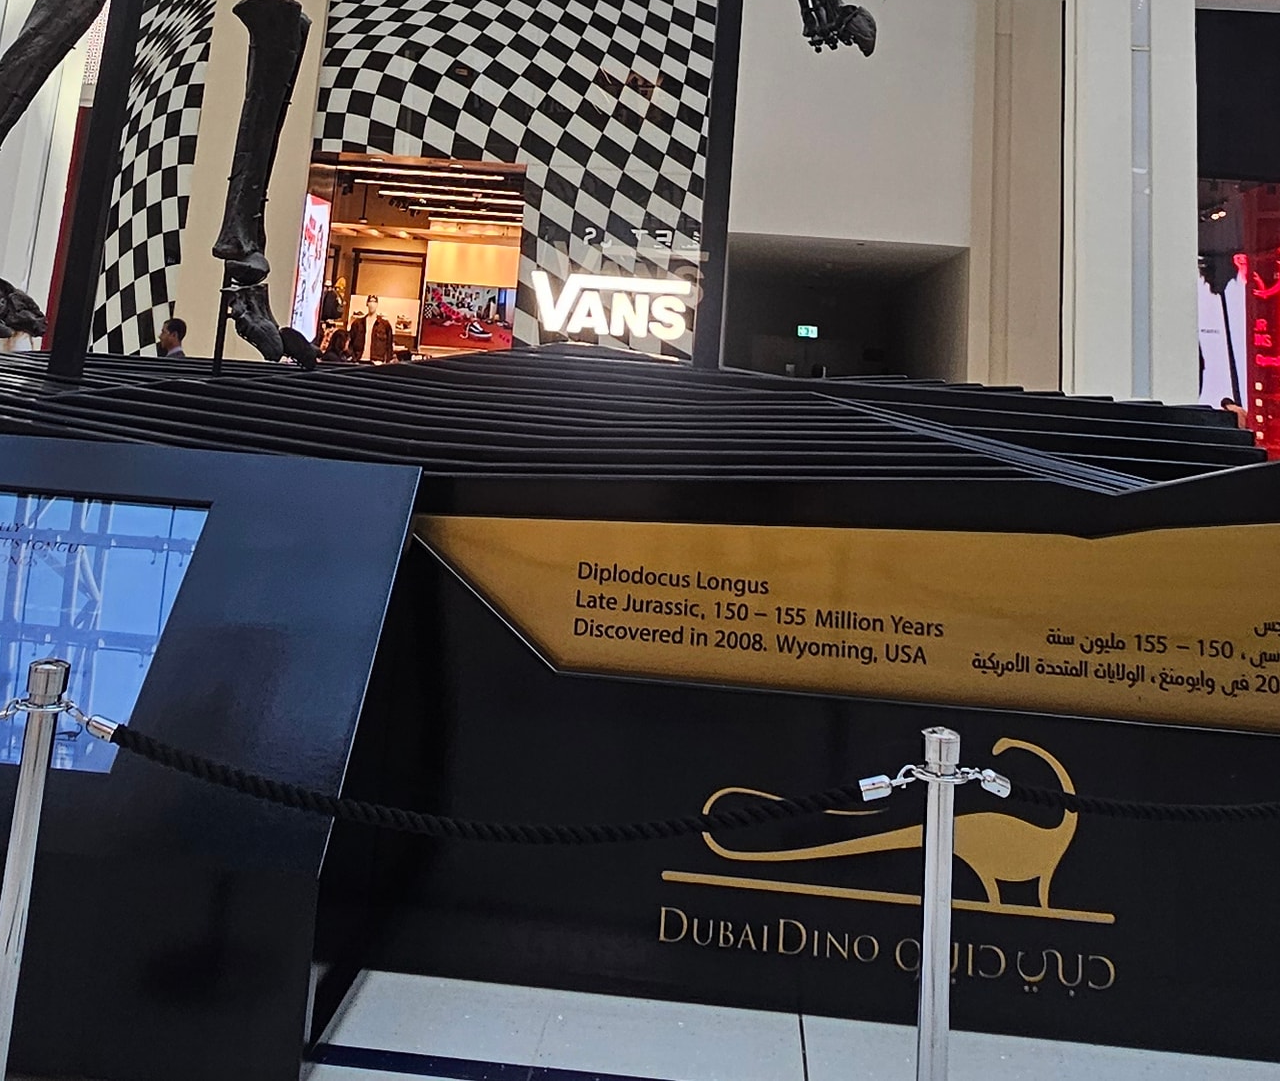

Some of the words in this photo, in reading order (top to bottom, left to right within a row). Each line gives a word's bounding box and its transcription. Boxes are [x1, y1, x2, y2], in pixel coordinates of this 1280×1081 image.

[531, 270, 692, 340] VANS
[578, 561, 691, 586] Diplodocus
[697, 571, 769, 597] Longus
[576, 590, 618, 610] Late
[622, 594, 705, 620] Jurassic,
[714, 601, 749, 621] 150
[775, 606, 806, 626] 155
[815, 609, 884, 632] Million
[891, 614, 945, 637] Years
[573, 618, 684, 645] Discovered
[690, 628, 708, 647] in
[714, 630, 768, 652] 2008.
[776, 634, 878, 665] Wyoming,
[885, 643, 928, 665] USA
[1046, 628, 1075, 647] سنة
[1079, 632, 1126, 655] مليون
[1134, 634, 1168, 654] 155
[1197, 639, 1234, 659] 150
[1035, 658, 1088, 678] المتحدة
[1221, 673, 1250, 698] في
